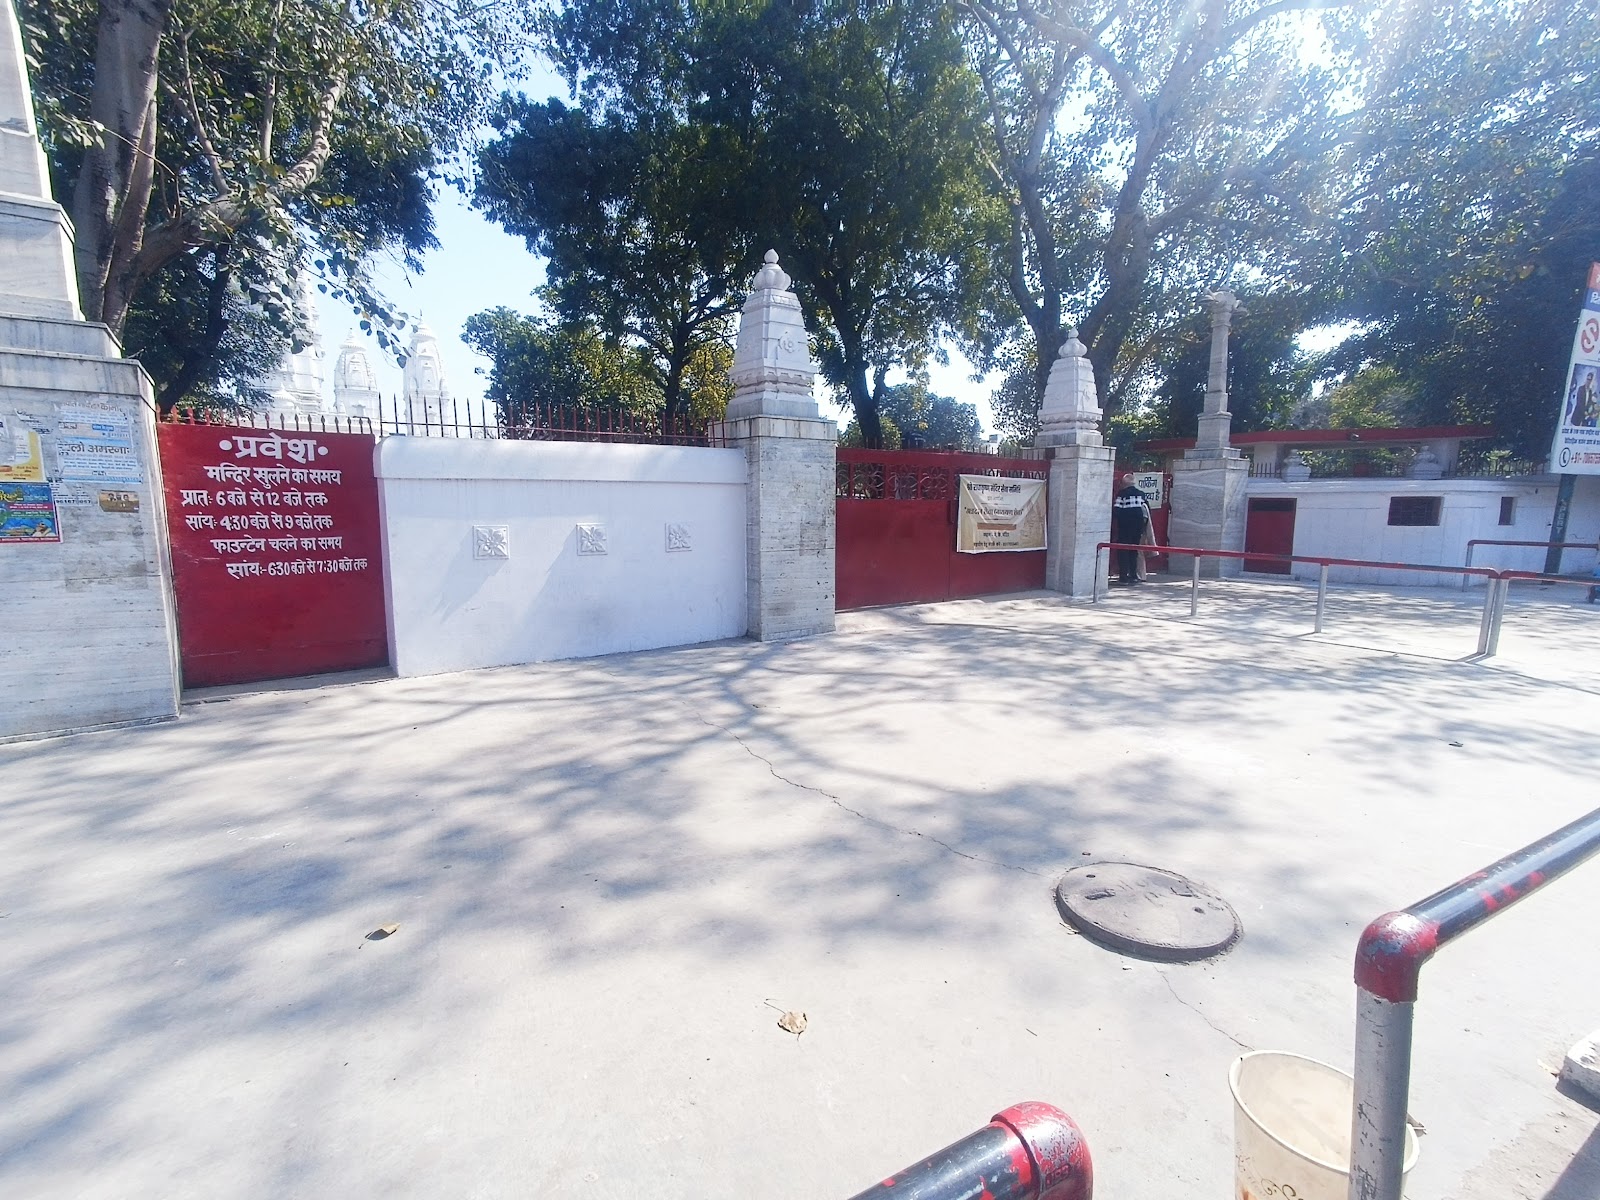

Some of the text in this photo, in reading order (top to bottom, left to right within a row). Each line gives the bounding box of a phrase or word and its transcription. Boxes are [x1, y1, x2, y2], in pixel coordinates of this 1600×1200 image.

[232, 432, 317, 464] प्रवेश
[204, 462, 341, 489] मन्दिर खुलने का समय
[216, 492, 226, 506] 6
[227, 489, 247, 506] बजे
[250, 488, 264, 506] से
[266, 493, 280, 506] 12
[283, 489, 302, 506] बजे
[305, 492, 328, 507] तक
[220, 515, 249, 530] 4:30
[250, 513, 270, 529] बजे
[272, 512, 284, 529] से
[285, 516, 294, 529] 9
[295, 513, 313, 529] बजे
[313, 515, 333, 530] तक
[211, 535, 342, 554] फाउन्टेन चलने का समय
[291, 559, 306, 575] बजे
[306, 559, 316, 574] से
[317, 561, 338, 573] 7:30
[338, 557, 354, 572] बजे
[354, 558, 368, 572] तक
